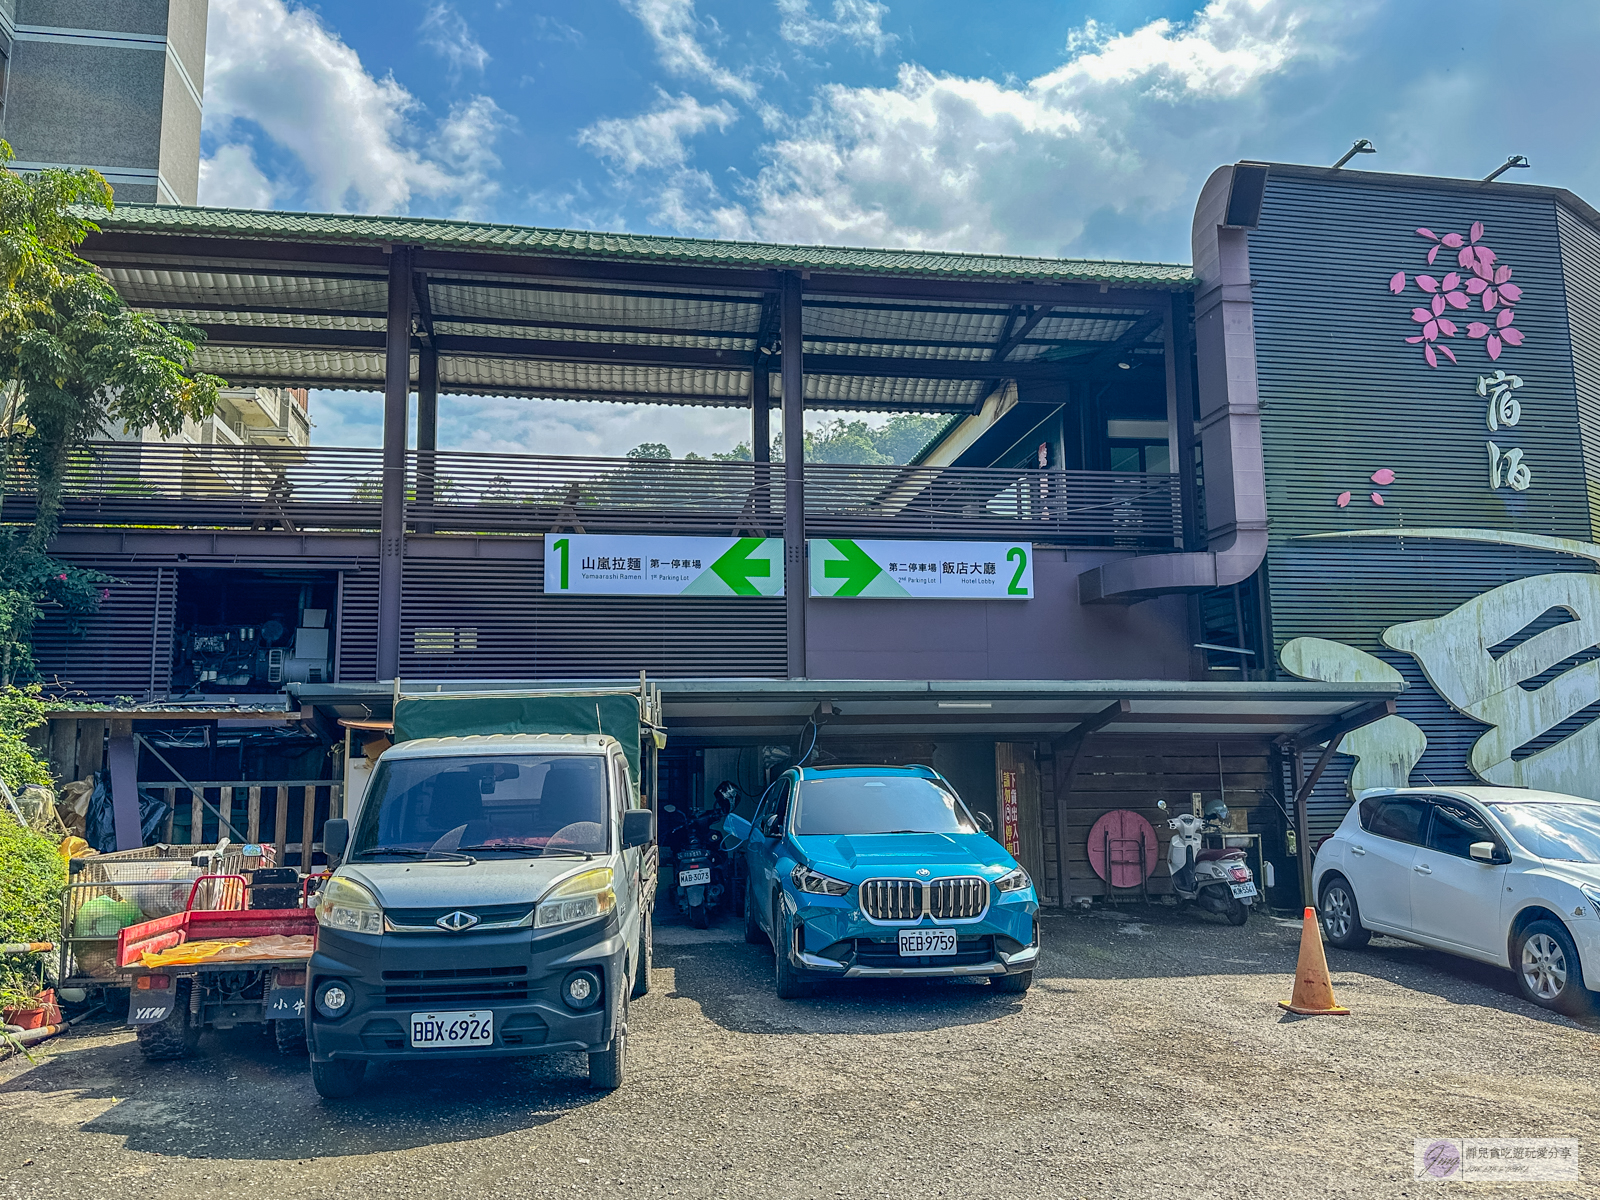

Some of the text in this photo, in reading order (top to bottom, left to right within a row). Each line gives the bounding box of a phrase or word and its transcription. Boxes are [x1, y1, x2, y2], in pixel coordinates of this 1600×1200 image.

[553, 538, 569, 590] 1
[582, 556, 642, 571] 山嵐拉麵
[650, 558, 702, 569] 第一停車場
[889, 562, 937, 573] 第二停車場
[942, 561, 997, 575] 飯店大廳
[581, 572, 619, 581] Yamaarashi
[1006, 547, 1028, 595] 2
[659, 574, 679, 582] Parking
[908, 577, 927, 585] Parking
[135, 1006, 167, 1020] YKM
